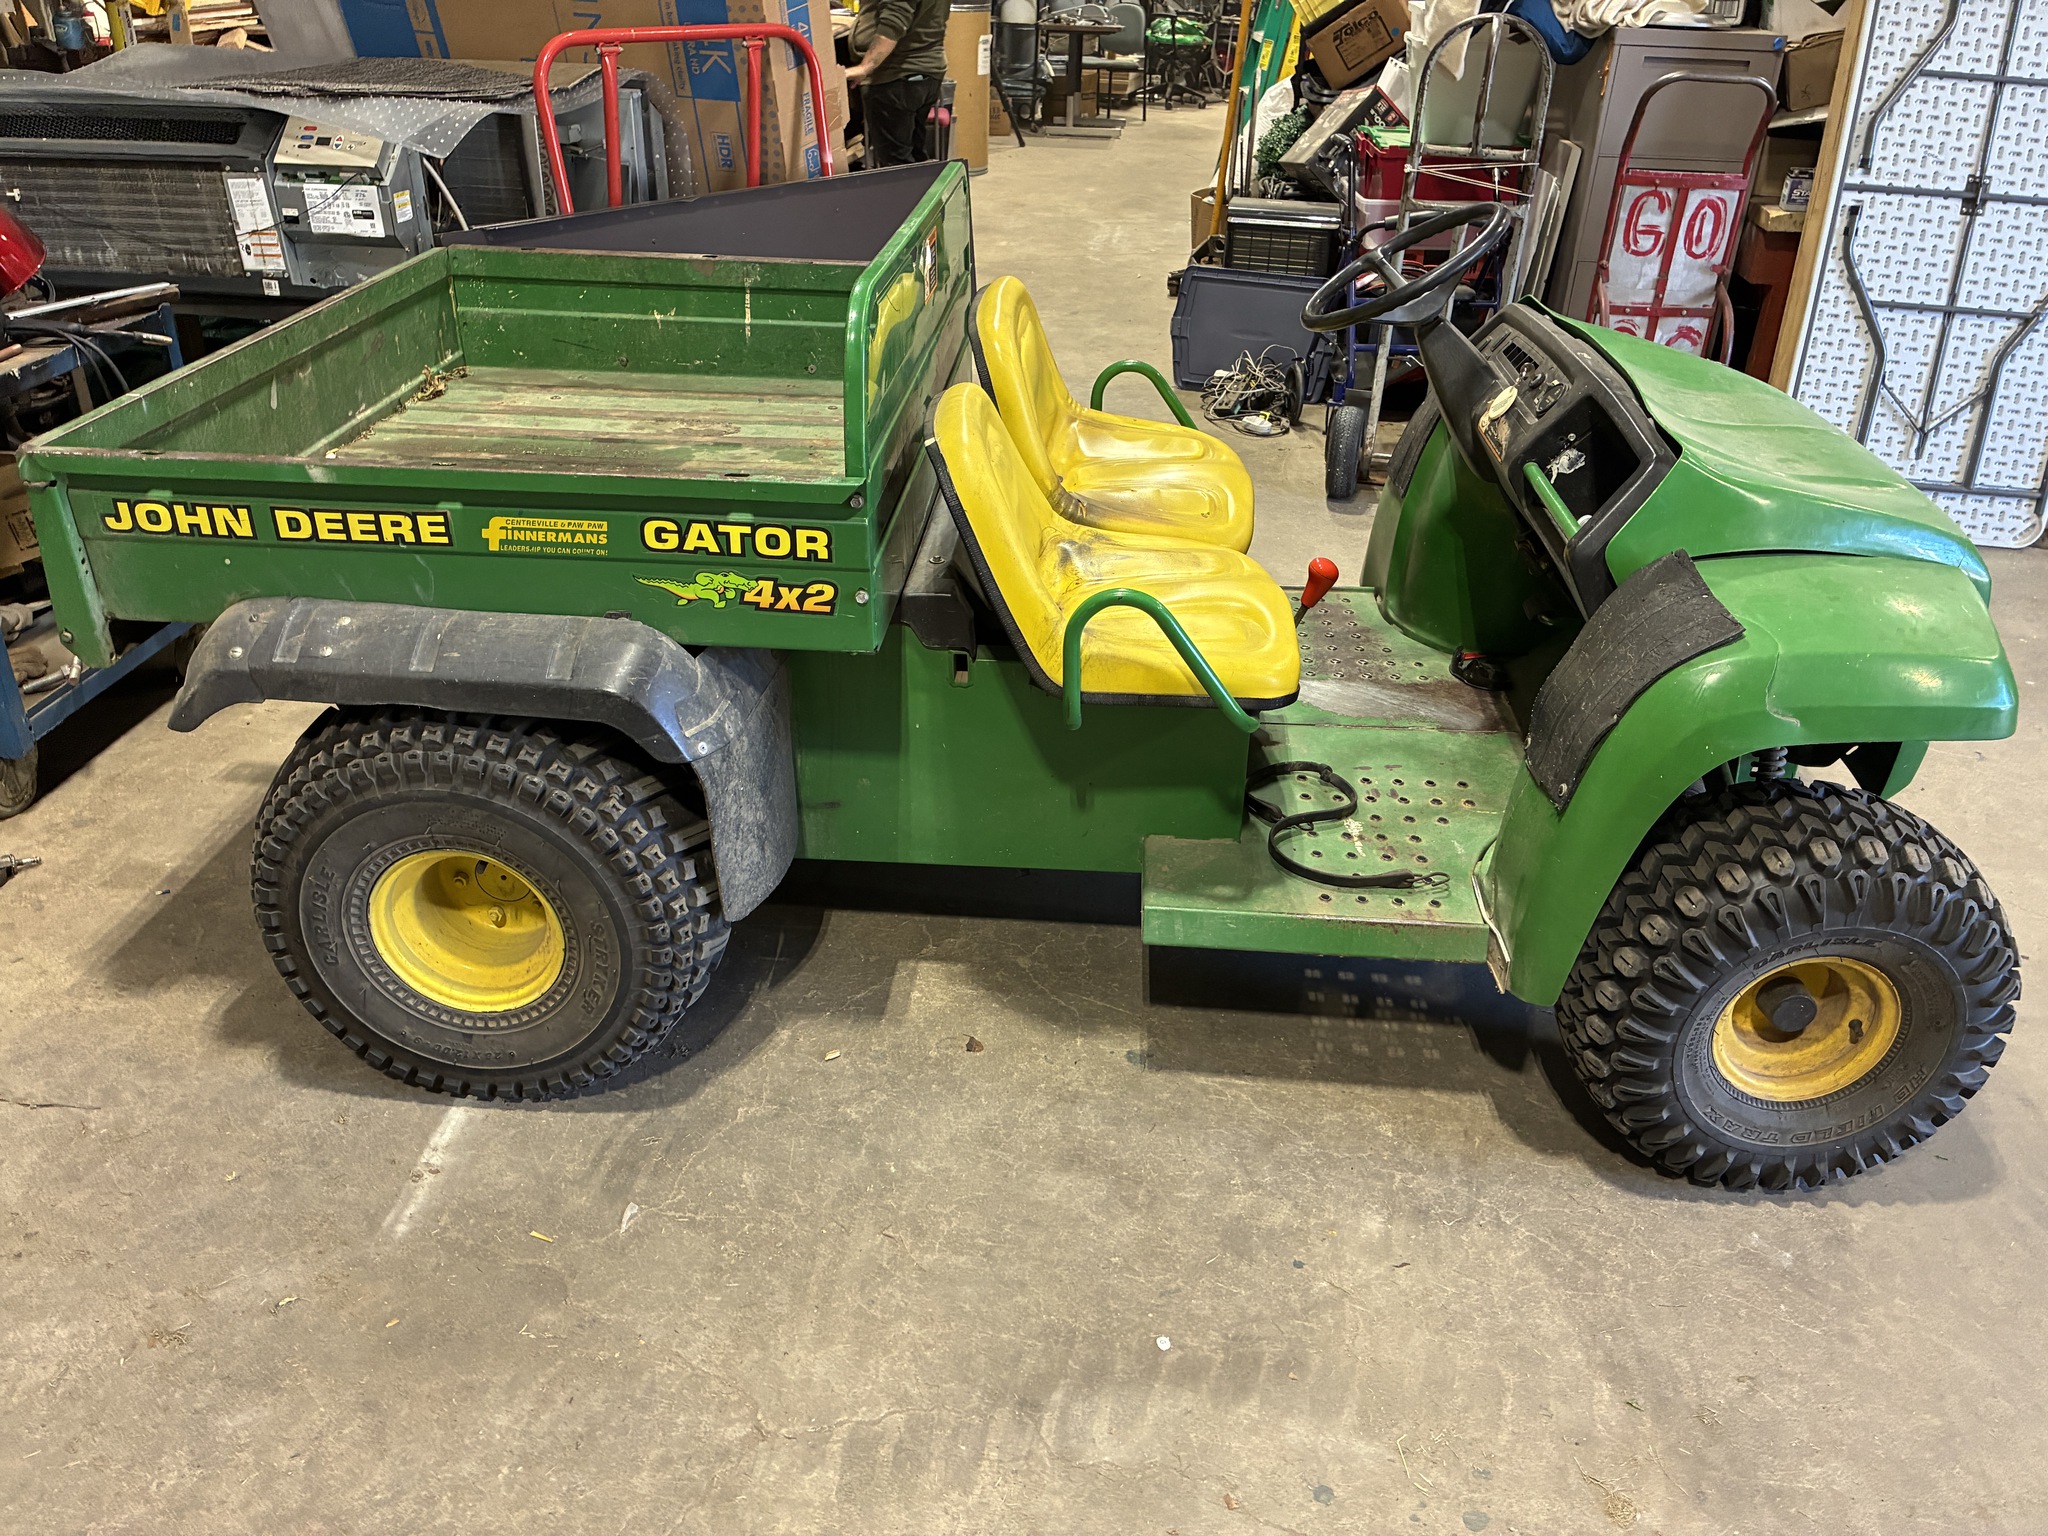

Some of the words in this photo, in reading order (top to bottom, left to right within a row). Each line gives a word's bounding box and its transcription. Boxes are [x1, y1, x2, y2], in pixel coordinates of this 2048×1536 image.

[803, 92, 815, 135] FRAGILE
[717, 134, 733, 169] HDR
[1622, 189, 1728, 261] GO
[103, 500, 255, 538] JOHN
[273, 508, 451, 545] DEERE
[505, 518, 559, 528] CENTREVILLE
[567, 521, 584, 529] PAW
[587, 522, 604, 530] PAW
[642, 518, 831, 561] GATOR
[543, 546, 556, 554] YOU
[557, 547, 571, 555] CAN
[596, 548, 609, 556] ON!
[741, 577, 837, 614] 4x2
[312, 866, 339, 966] CARLISLE
[1752, 937, 1882, 970] CARLISLE
[1702, 1104, 1779, 1144] TRAX
[1791, 1104, 1885, 1144] FIELD
